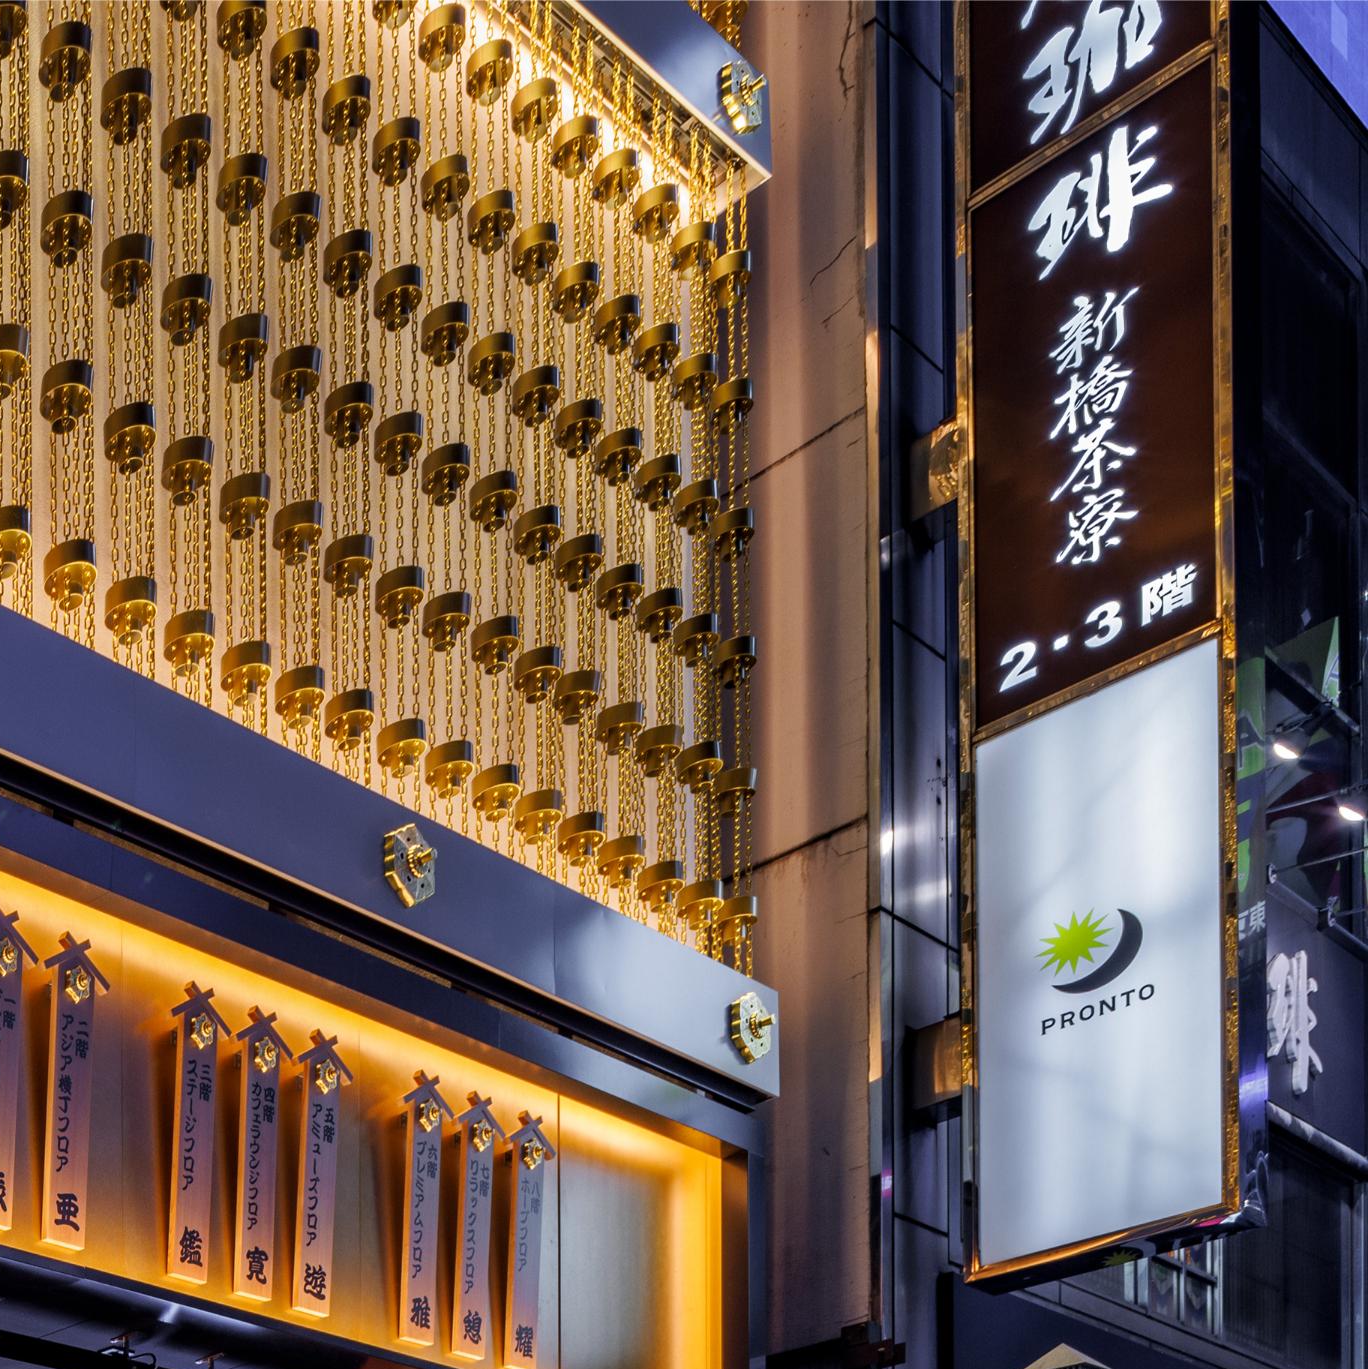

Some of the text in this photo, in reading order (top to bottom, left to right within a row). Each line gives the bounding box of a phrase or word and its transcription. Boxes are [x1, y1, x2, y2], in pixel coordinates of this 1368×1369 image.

[1020, 0, 1174, 282] 珈琲
[1048, 287, 1139, 565] 新橋茶寮
[2, 997, 16, 1029] 一階
[1041, 983, 1156, 1036] PRONTO
[75, 1021, 89, 1059] 二階
[199, 1064, 212, 1102] 三階
[263, 1087, 275, 1123] 四階
[322, 1107, 334, 1143] 五階
[54, 1192, 80, 1232] 亜
